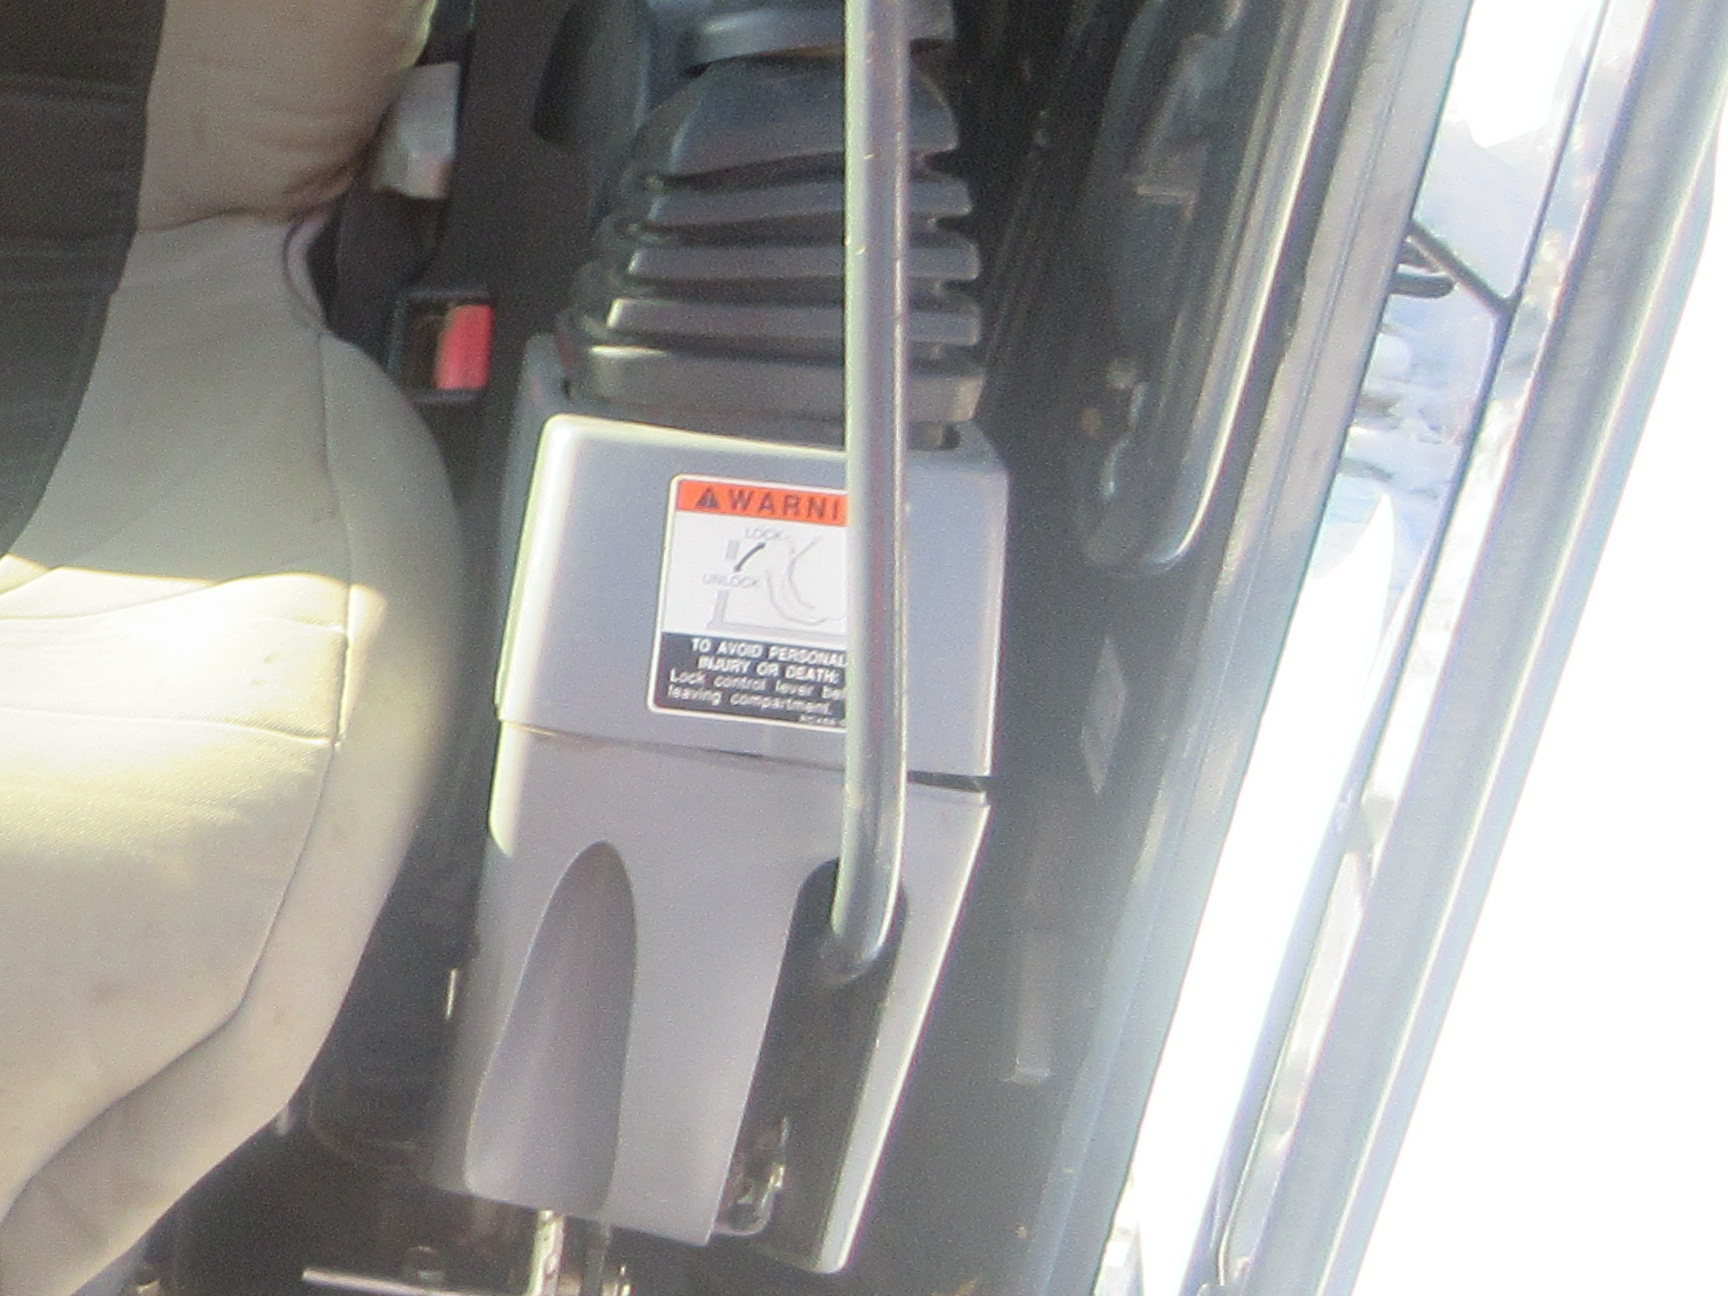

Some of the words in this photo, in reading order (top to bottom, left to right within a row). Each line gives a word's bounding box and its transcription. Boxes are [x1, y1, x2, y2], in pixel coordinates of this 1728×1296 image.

[729, 489, 840, 521] WARNI
[745, 526, 783, 541] LOCK
[702, 573, 760, 589] UNLOCK
[691, 638, 712, 653] TO
[716, 641, 764, 658] AVOID
[768, 646, 847, 668] PERSONAL
[698, 656, 751, 674] INJURY
[756, 661, 781, 677] OR
[670, 668, 707, 685] Lock
[713, 674, 768, 692] control
[775, 679, 816, 697] lever
[667, 684, 723, 706] leaving
